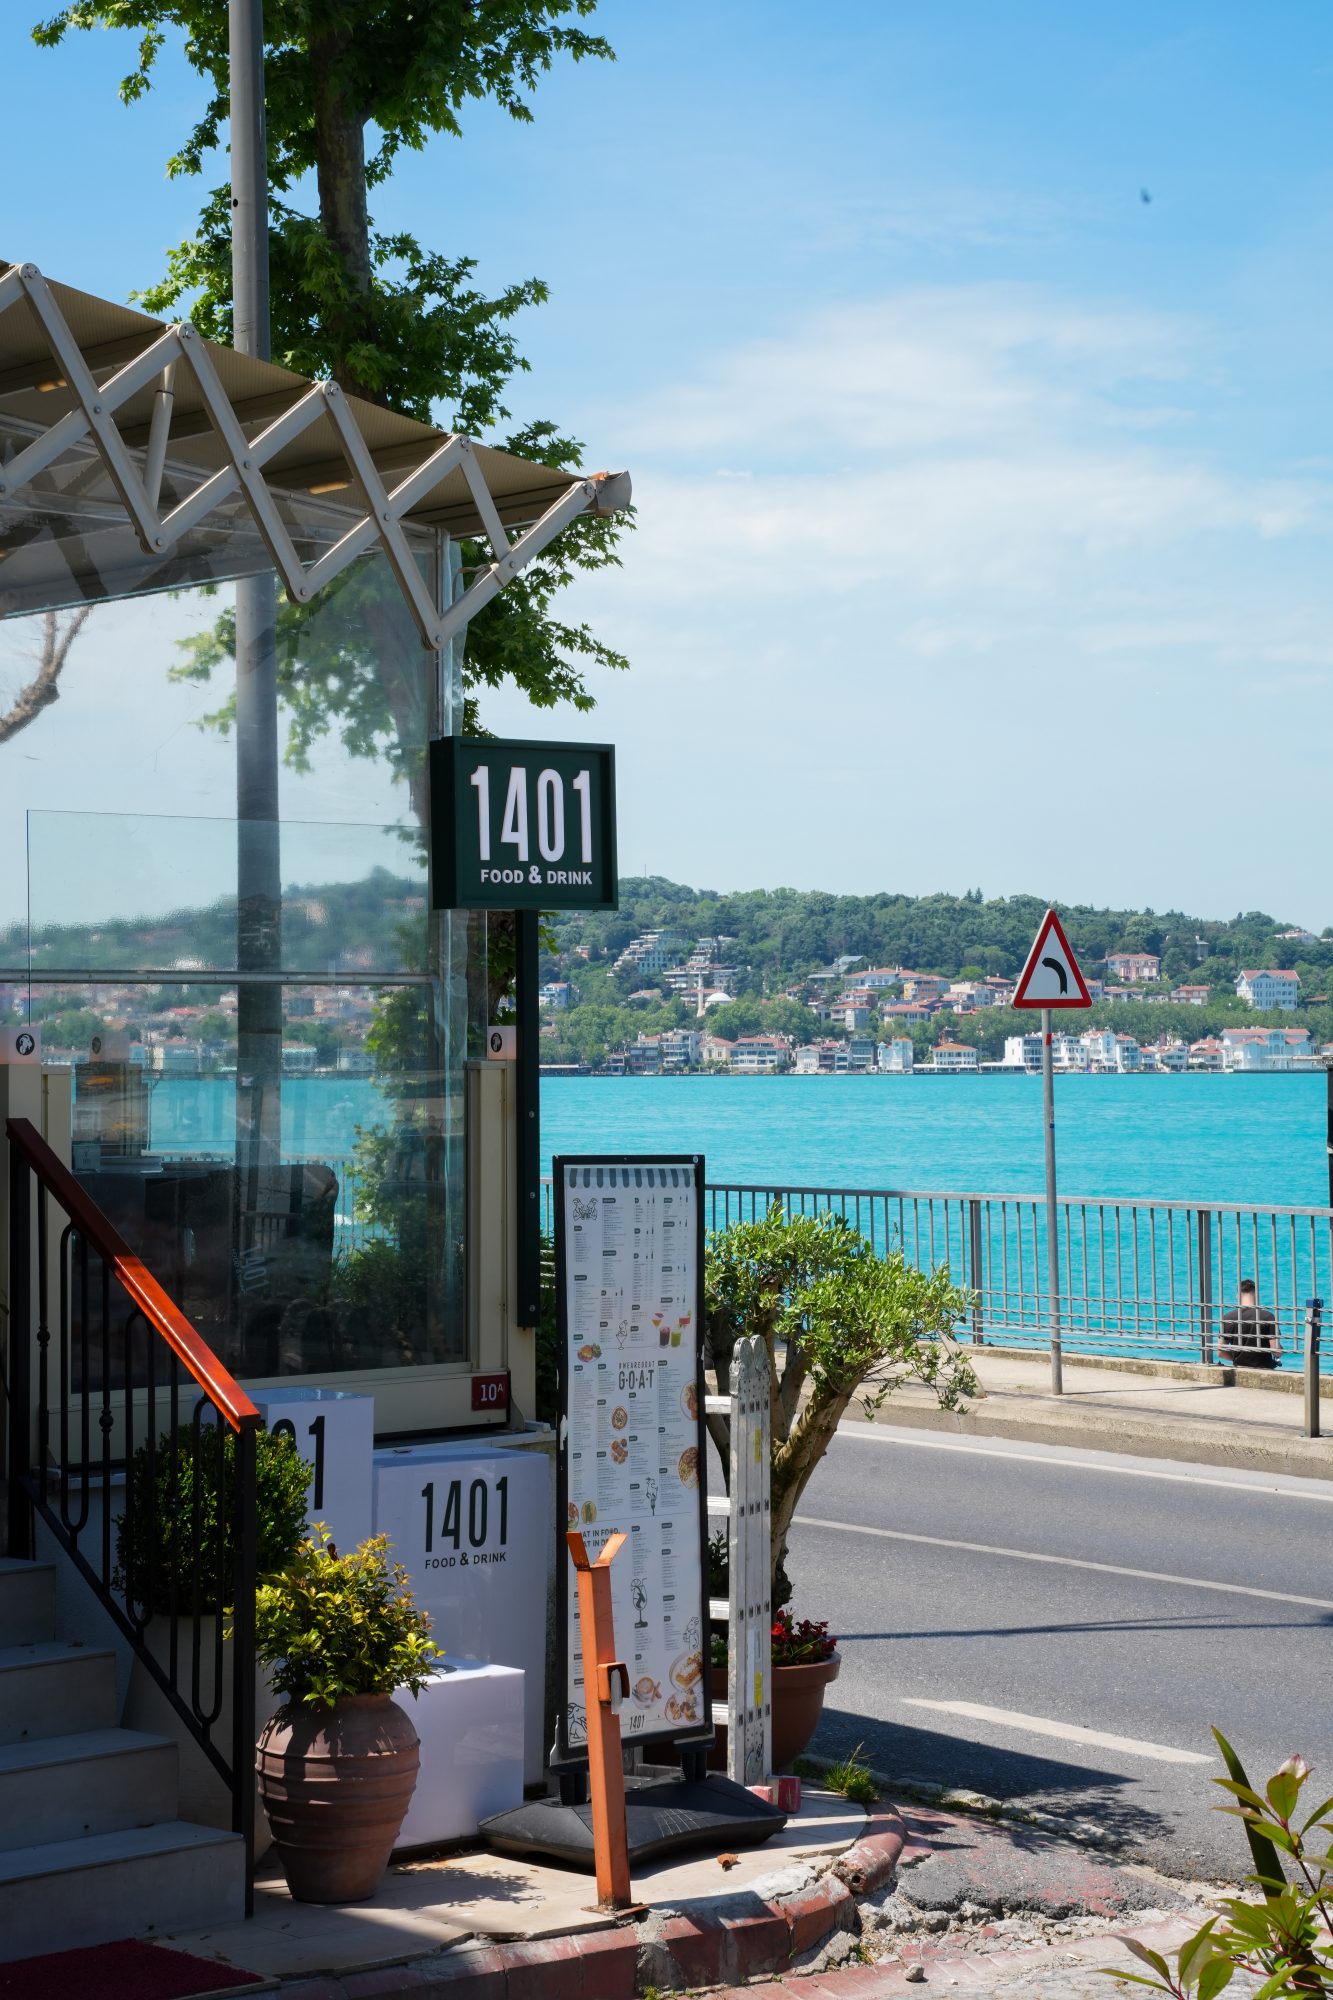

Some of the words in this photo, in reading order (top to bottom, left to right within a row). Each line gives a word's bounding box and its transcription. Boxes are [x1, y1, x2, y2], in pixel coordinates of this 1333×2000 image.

[470, 765, 593, 864] 1401
[480, 868, 524, 884] FOOD
[528, 865, 543, 884] &
[546, 870, 593, 885] DRINK
[421, 1476, 508, 1553] 1401
[592, 1529, 600, 1537] IN
[592, 1539, 600, 1547] IN
[425, 1557, 456, 1569] FOOD
[460, 1552, 469, 1566] &
[473, 1551, 507, 1565] DRINK
[629, 1714, 645, 1731] 1401
